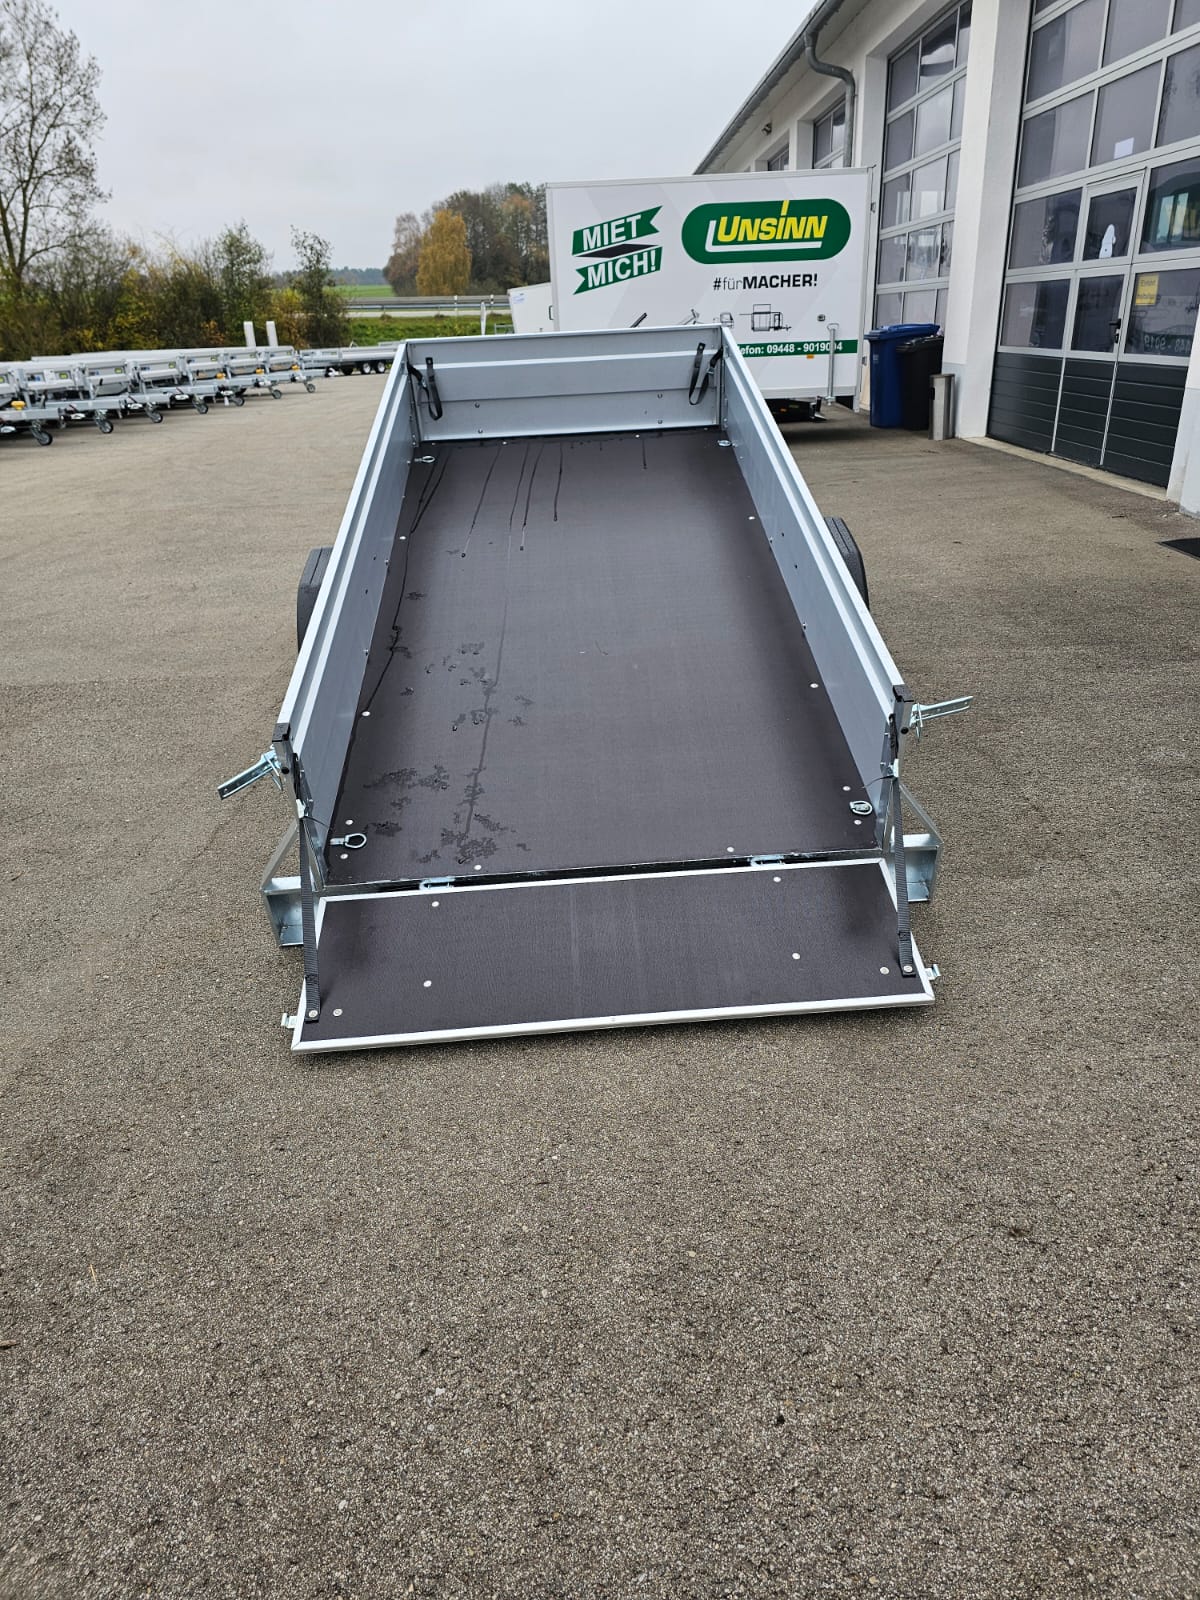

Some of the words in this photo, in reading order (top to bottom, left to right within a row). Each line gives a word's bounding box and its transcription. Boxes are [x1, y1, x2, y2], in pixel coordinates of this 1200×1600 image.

[582, 214, 642, 251] MIET
[587, 249, 656, 288] MICH!
[713, 273, 818, 291] #fürMACHER!
[738, 344, 764, 355] efon:
[766, 343, 795, 354] 09448
[803, 341, 843, 353] 901904
